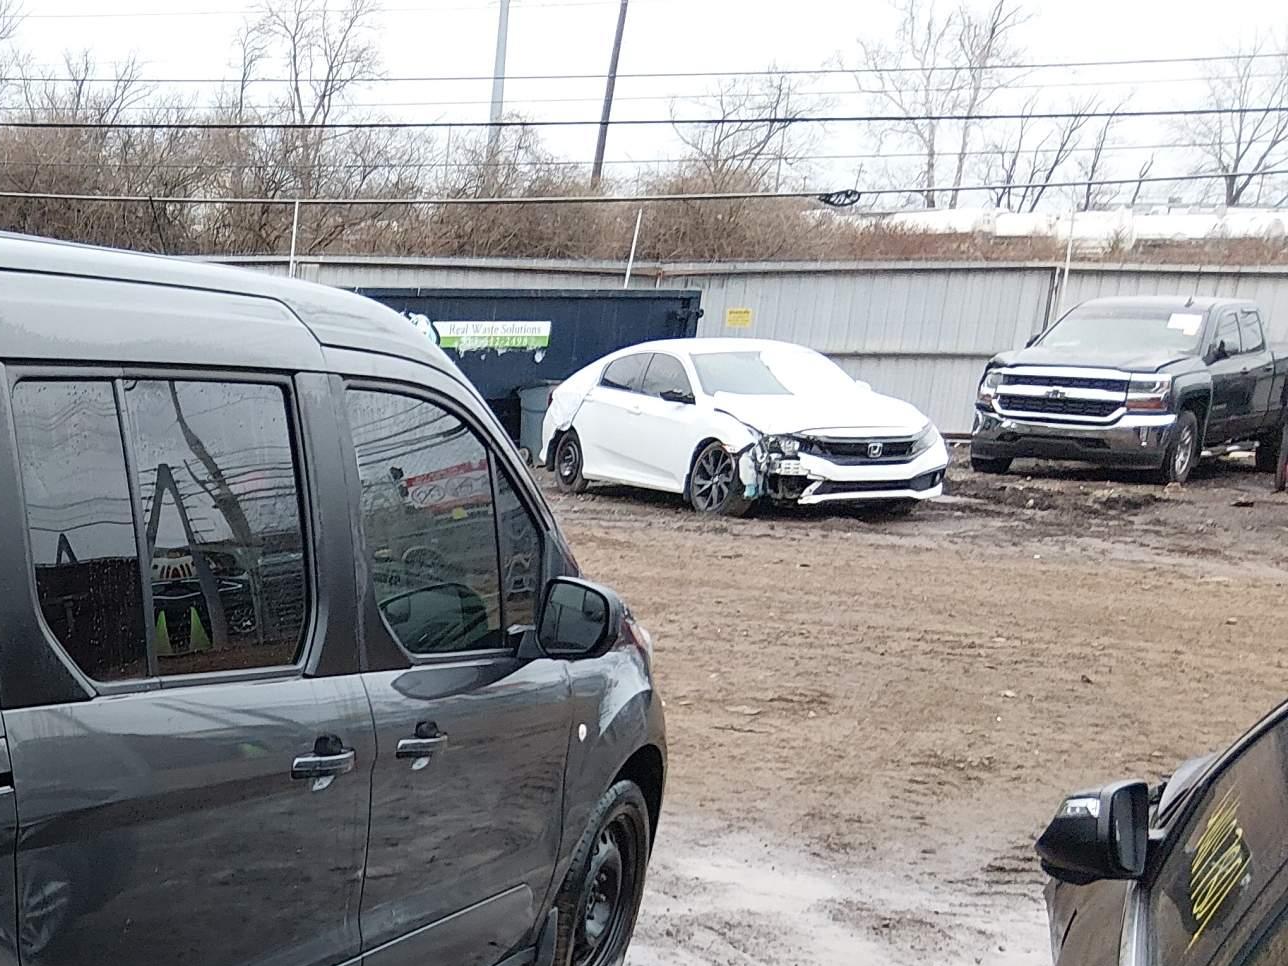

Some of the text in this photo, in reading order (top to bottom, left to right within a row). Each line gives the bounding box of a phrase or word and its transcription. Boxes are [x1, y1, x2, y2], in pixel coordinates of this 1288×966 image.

[448, 322, 542, 335] Real Waste Solutions
